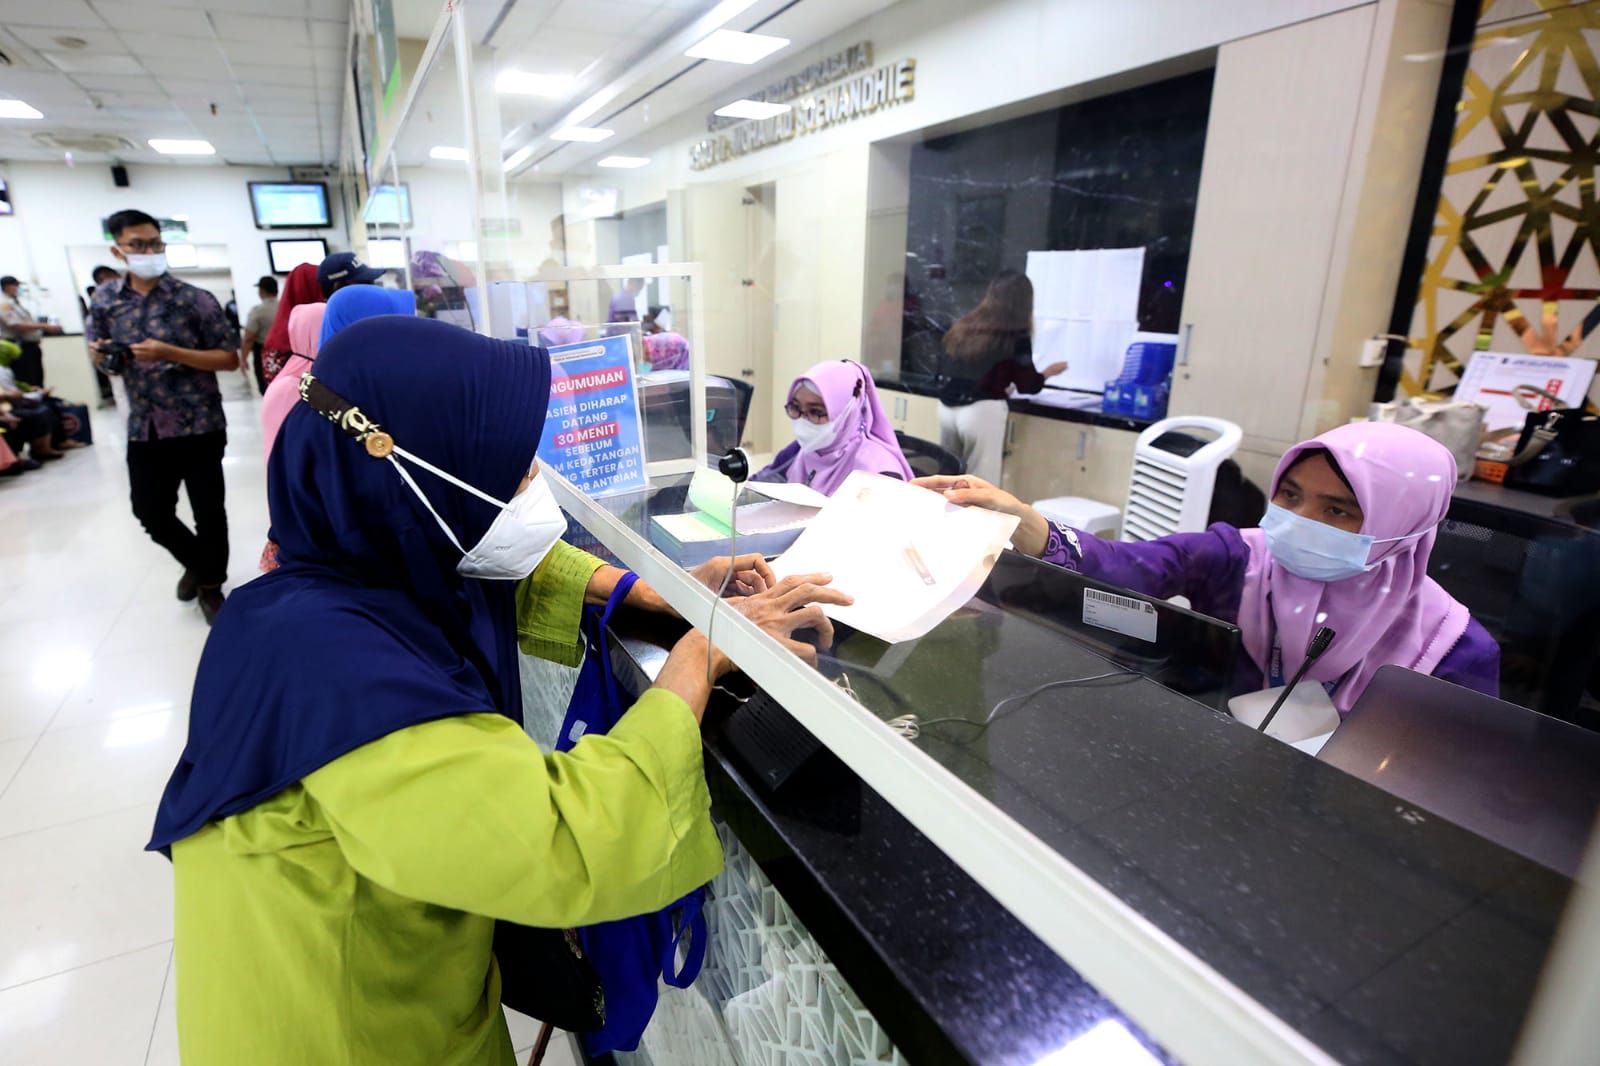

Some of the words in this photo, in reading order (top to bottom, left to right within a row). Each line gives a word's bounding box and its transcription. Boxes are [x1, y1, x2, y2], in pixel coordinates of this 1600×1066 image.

[551, 370, 624, 394] NGUMUMAN
[546, 405, 577, 420] ASIEN
[580, 394, 628, 412] DIHARAP
[562, 411, 608, 429] DATANG
[558, 433, 574, 446] 30
[577, 424, 616, 442] MENIT
[565, 439, 613, 457] SEBELUM
[567, 445, 639, 470] KEDATANGAN
[580, 461, 624, 479] TERTERA
[626, 458, 637, 467] DI
[593, 470, 638, 489] ANTRIAN
